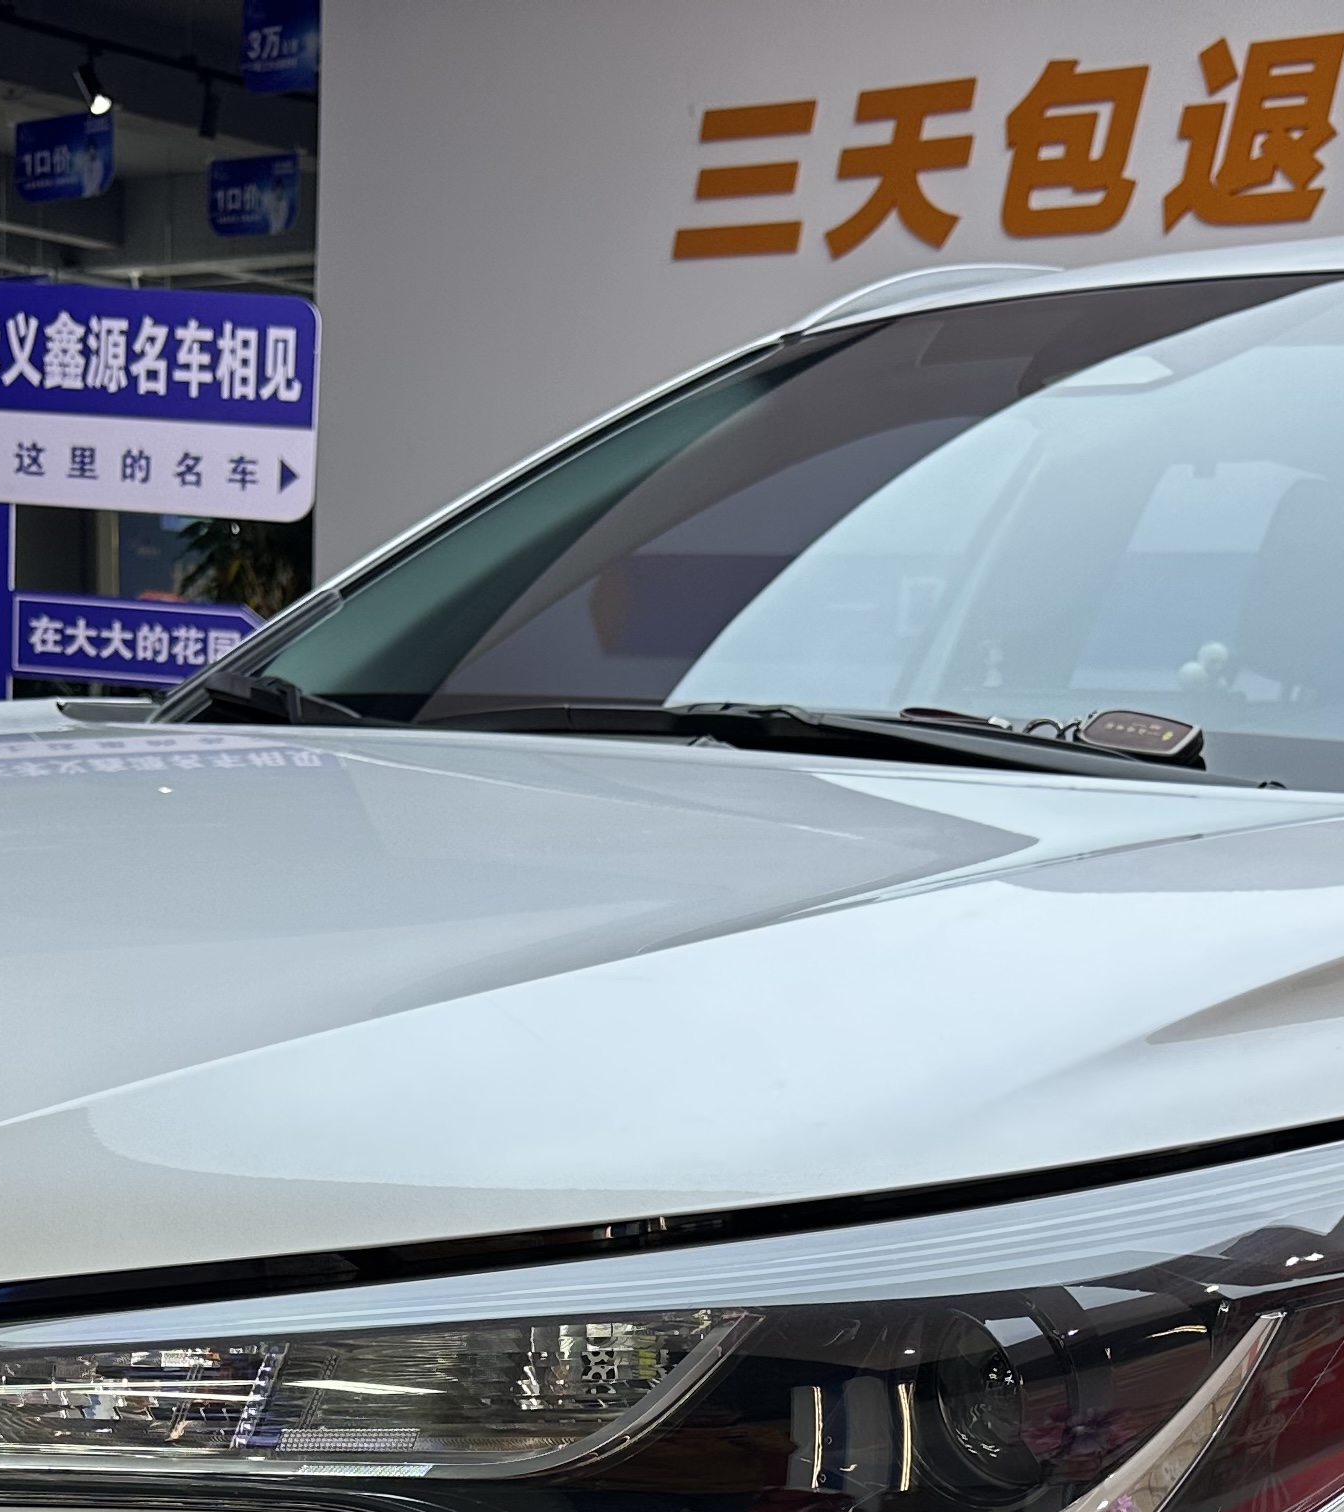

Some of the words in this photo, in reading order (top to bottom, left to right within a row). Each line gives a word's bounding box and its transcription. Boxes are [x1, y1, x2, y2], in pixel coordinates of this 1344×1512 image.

[28, 614, 242, 666] 在大大的花园
